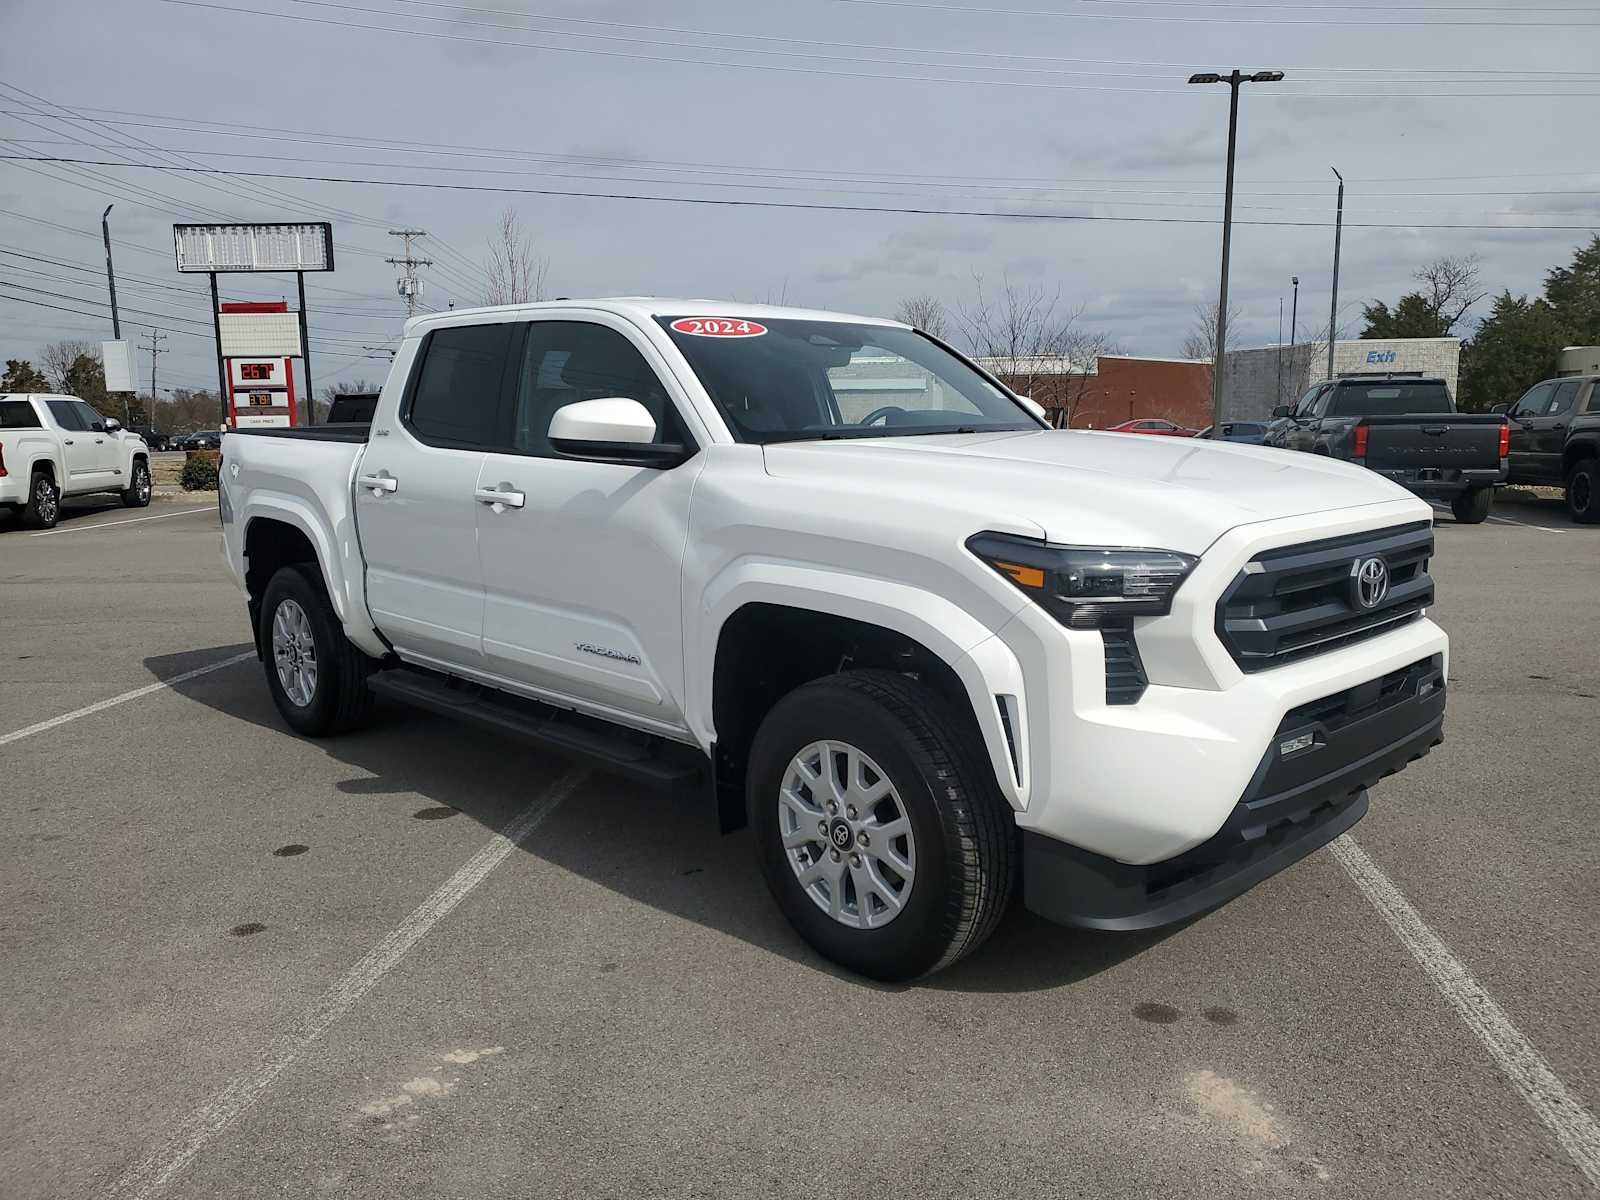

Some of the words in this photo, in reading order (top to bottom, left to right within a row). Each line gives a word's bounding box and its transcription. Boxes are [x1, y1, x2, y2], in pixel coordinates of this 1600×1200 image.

[688, 320, 751, 333] 2024
[1366, 350, 1397, 363] Exit
[575, 642, 641, 665] TACOMA
